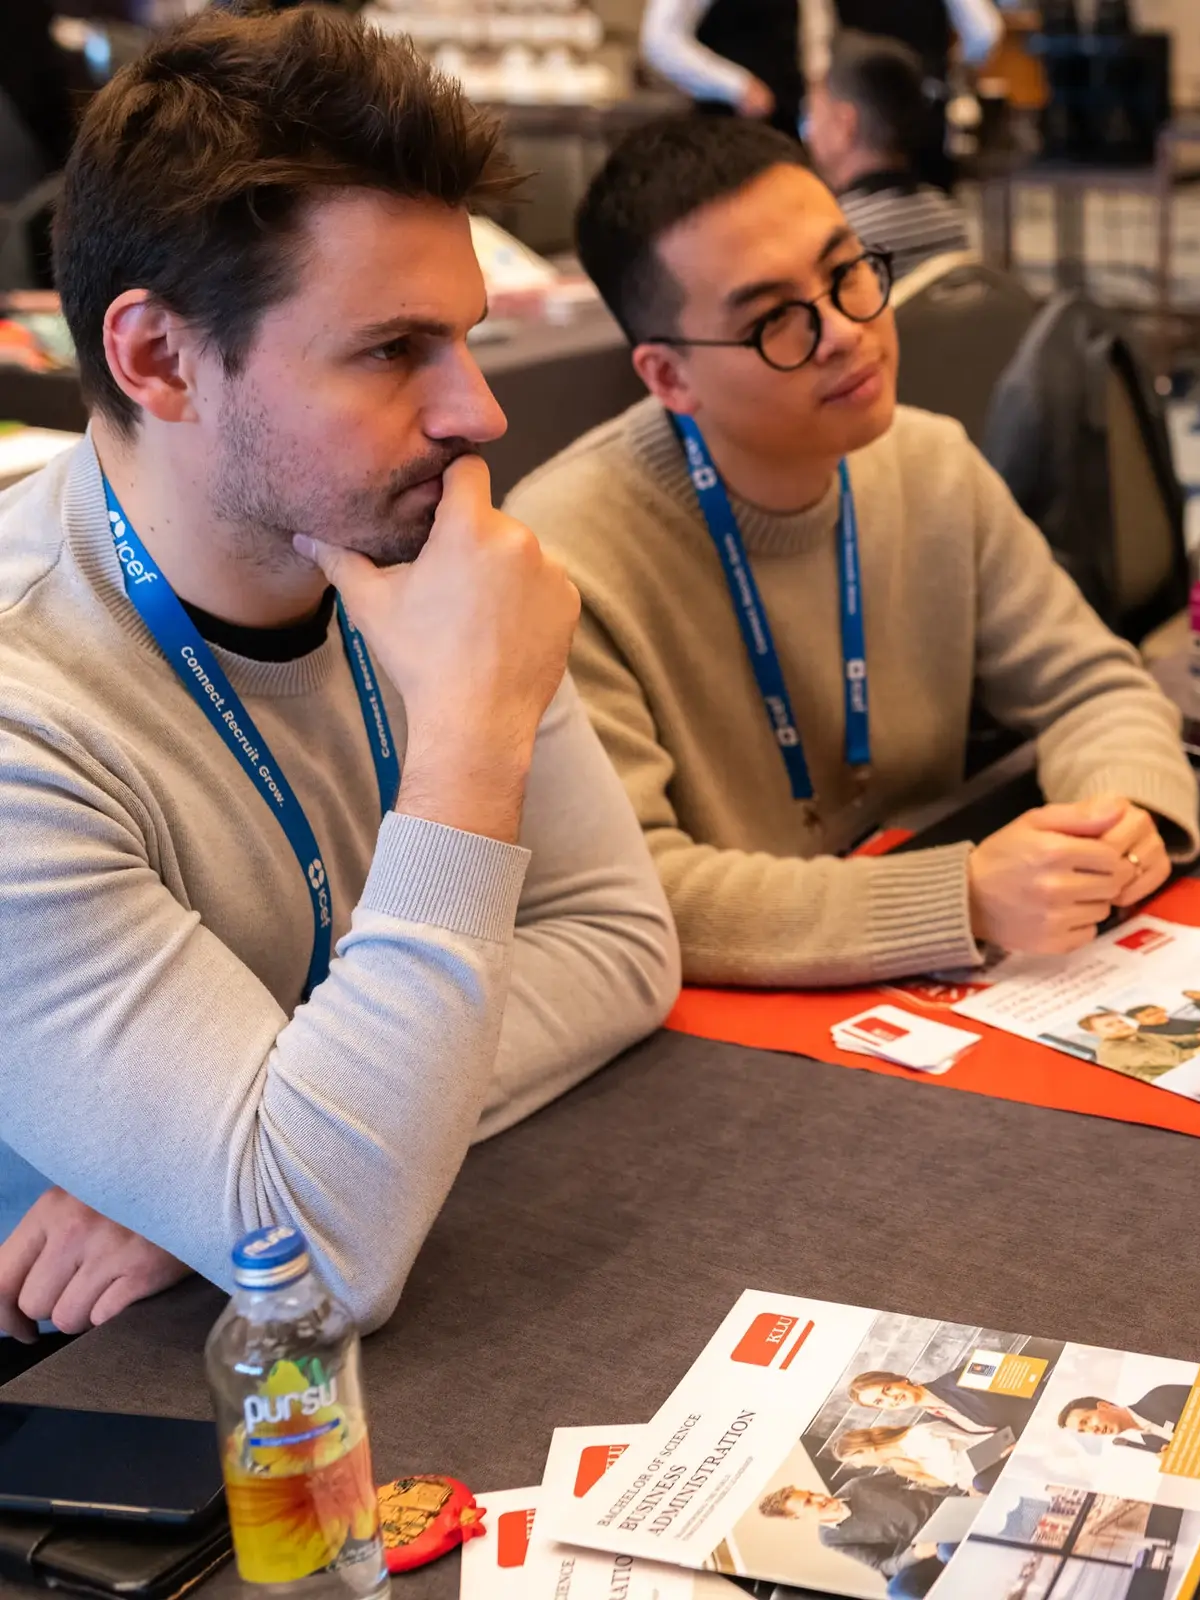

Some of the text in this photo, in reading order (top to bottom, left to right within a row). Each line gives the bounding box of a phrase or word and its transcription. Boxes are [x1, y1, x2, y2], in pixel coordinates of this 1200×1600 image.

[181, 645, 285, 808] Connect. Recruit. Grow.
[765, 1314, 794, 1344] KLU
[243, 1377, 338, 1434] pursu
[597, 1470, 651, 1527] BACHELOR
[648, 1456, 665, 1474] OF
[659, 1413, 702, 1458] SCIENCE
[619, 1464, 689, 1532] BUSINESS
[647, 1408, 757, 1537] ADMINISTRATION
